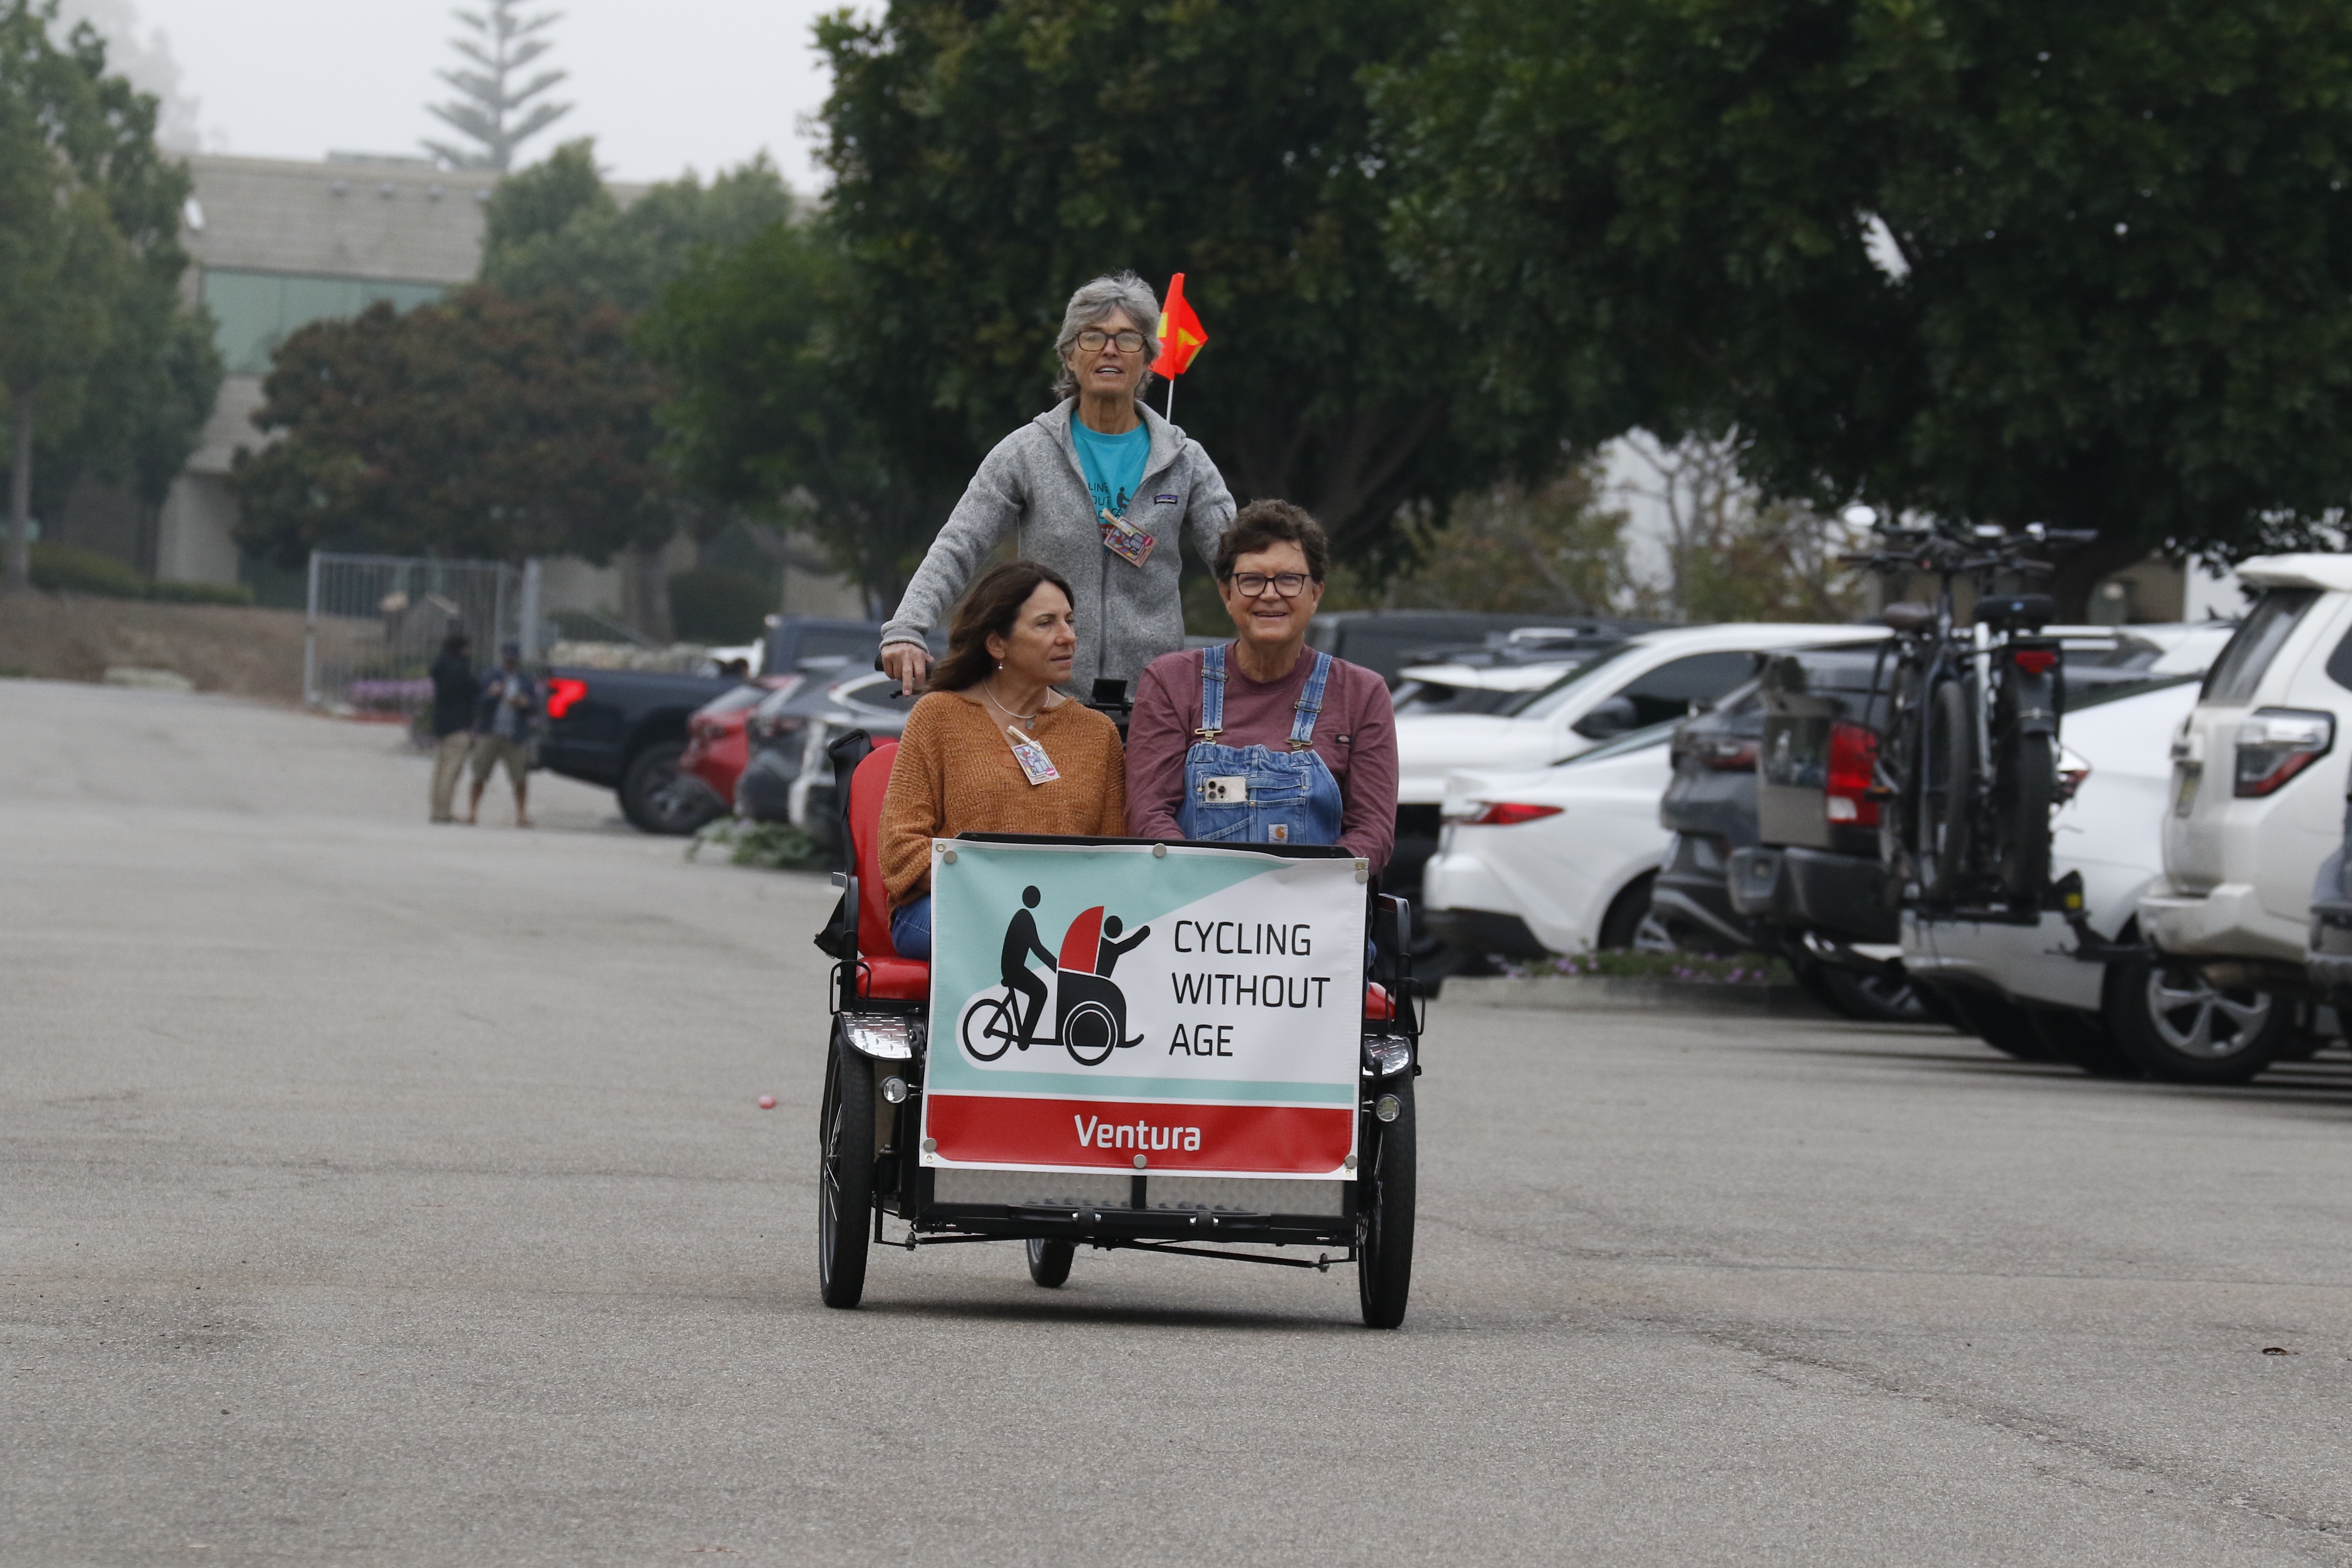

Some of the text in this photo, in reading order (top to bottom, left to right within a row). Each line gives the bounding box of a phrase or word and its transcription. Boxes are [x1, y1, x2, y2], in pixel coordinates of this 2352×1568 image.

[1174, 920, 1311, 956] CYCLING
[1171, 972, 1331, 1009] WITHOUT
[1168, 1023, 1234, 1057] AGE
[1074, 1114, 1201, 1152] Ventura
